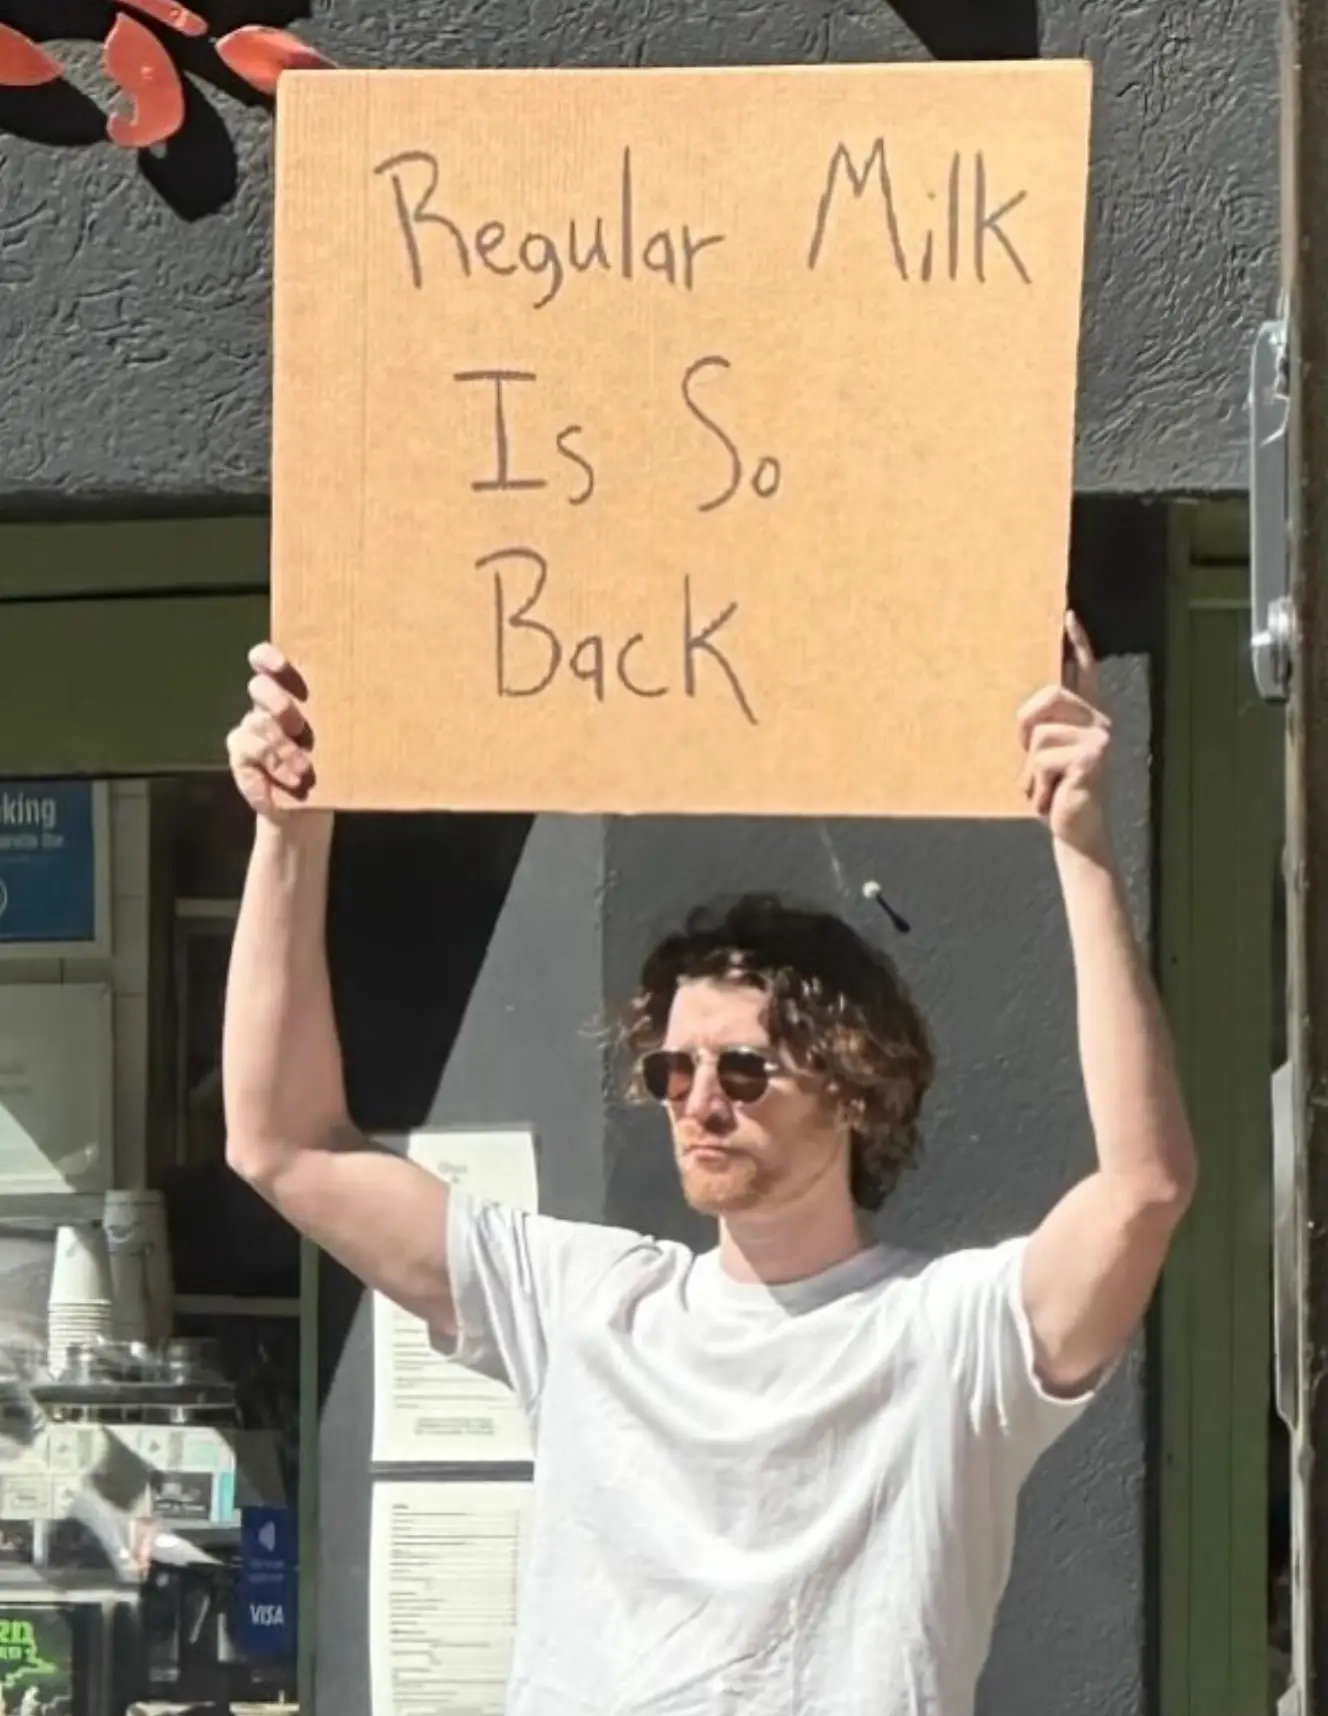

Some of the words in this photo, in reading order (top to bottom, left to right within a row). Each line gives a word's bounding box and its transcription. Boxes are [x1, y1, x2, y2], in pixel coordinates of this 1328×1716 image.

[373, 146, 726, 310] Regular
[807, 138, 1031, 285] Milk
[453, 370, 594, 505] Is
[682, 356, 781, 512] So
[475, 548, 758, 725] Back
[0, 791, 56, 830] king
[250, 1604, 284, 1626] VISA
